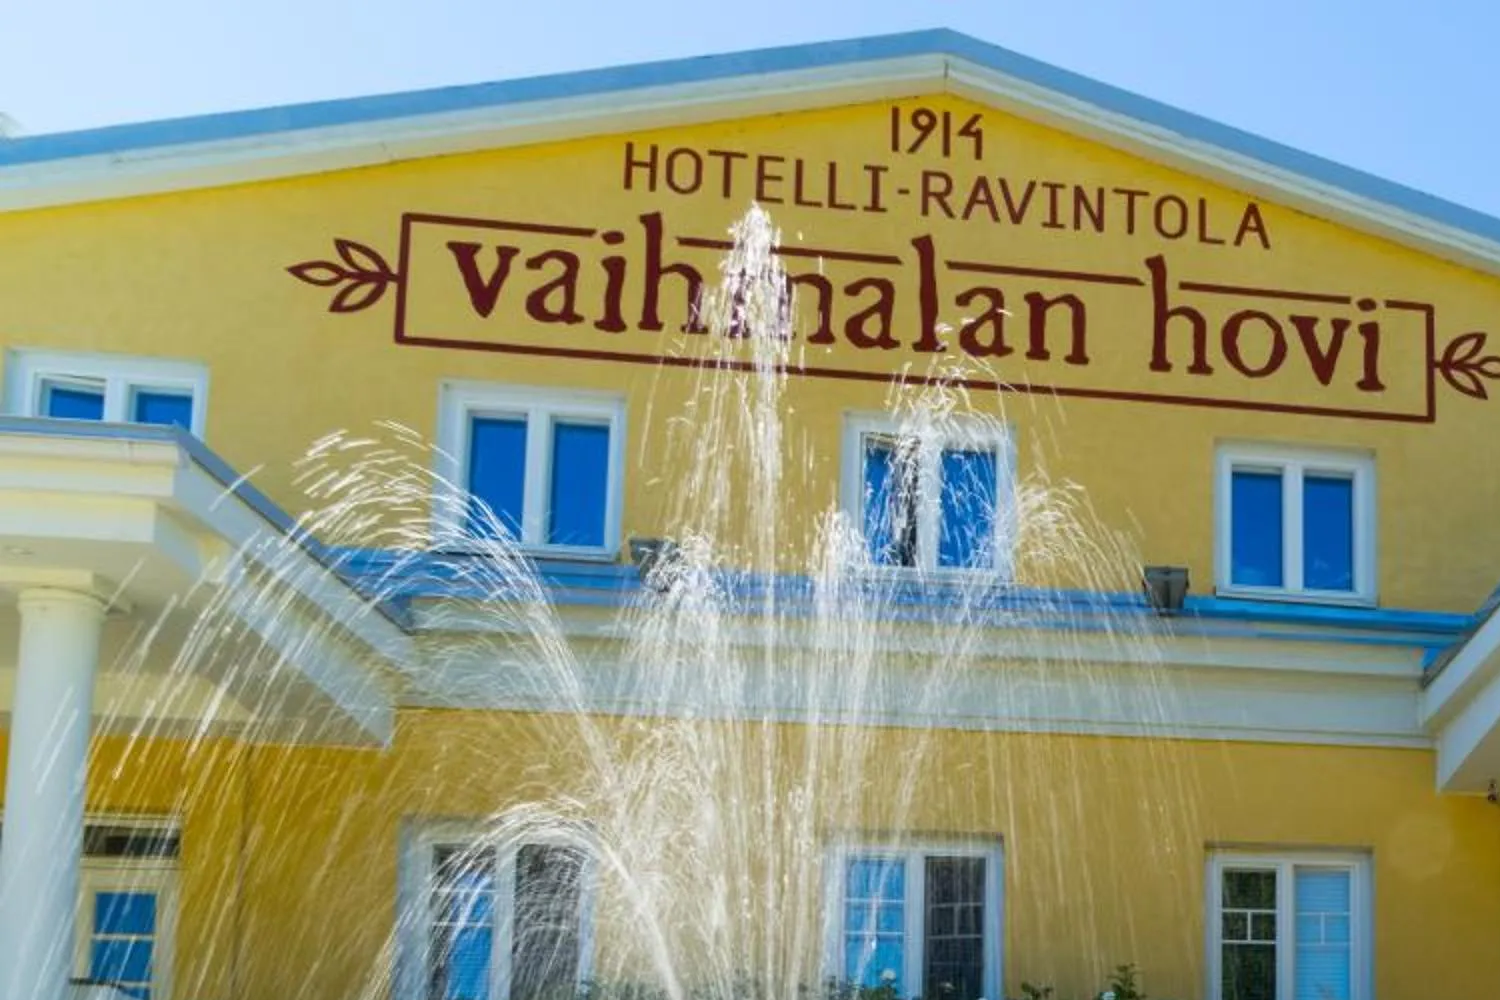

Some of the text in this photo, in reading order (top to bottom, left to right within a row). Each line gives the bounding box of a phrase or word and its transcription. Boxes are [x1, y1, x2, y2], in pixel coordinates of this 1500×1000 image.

[890, 105, 984, 160] 1914
[622, 141, 1272, 250] HOTELLI-RAVINTOLA
[1145, 254, 1386, 392] hovi
